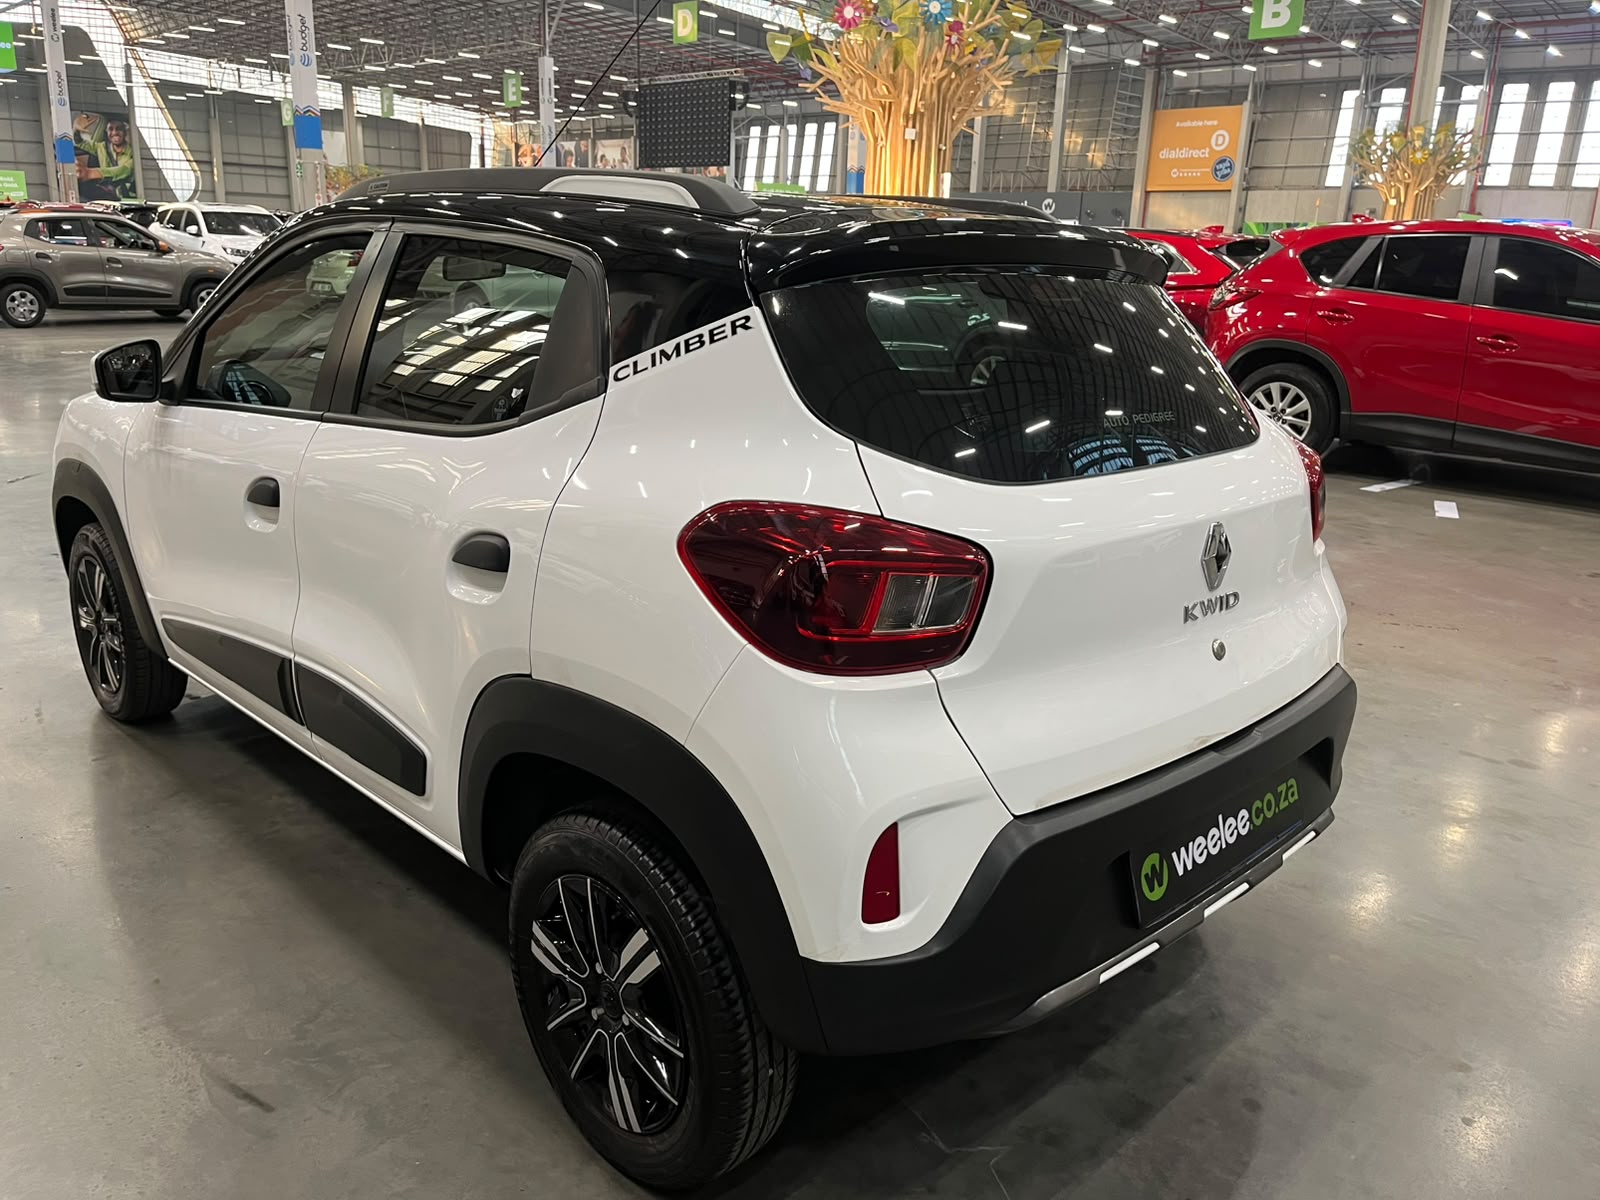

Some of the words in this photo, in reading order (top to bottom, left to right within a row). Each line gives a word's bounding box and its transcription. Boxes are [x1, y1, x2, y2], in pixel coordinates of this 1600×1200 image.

[677, 9, 693, 37] D
[1261, 0, 1291, 29] B
[297, 14, 309, 51] budget
[383, 90, 390, 113] F
[508, 78, 517, 102] E
[284, 104, 291, 122] G
[1159, 147, 1210, 159] dialdirect
[613, 315, 755, 382] CLIMBER
[1103, 415, 1130, 428] AUTO
[1132, 411, 1176, 424] PEDIGREE
[1183, 591, 1240, 624] KWID
[1171, 777, 1299, 877] weelee.co.za
